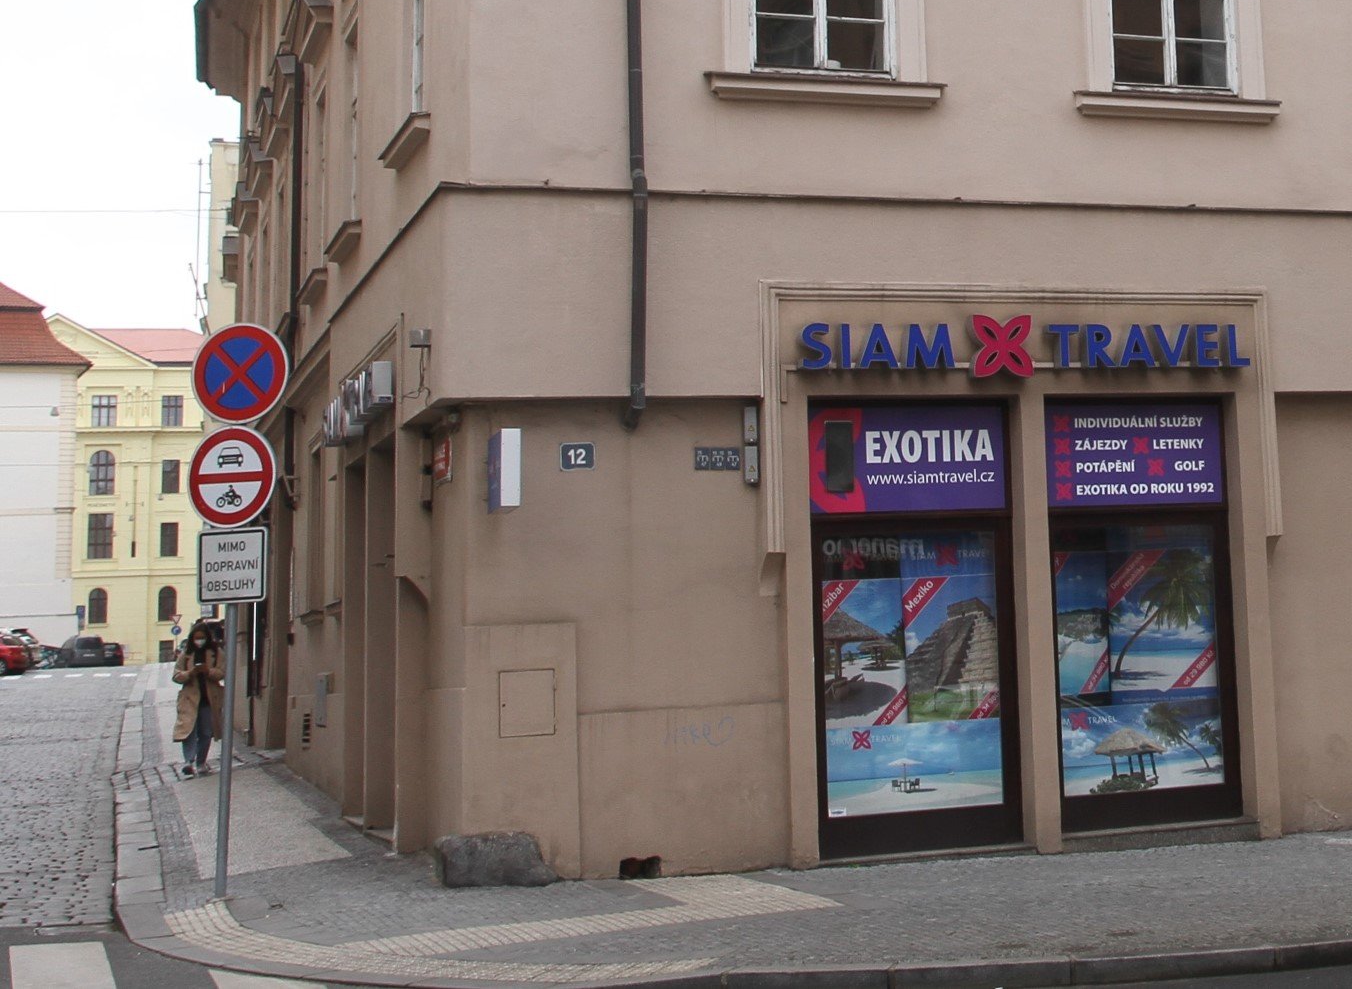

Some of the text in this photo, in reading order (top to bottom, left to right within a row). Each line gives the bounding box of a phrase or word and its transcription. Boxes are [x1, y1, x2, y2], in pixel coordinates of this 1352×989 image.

[800, 322, 1250, 369] SIAM TRAVEL
[1074, 415, 1203, 428] INDIVIDUÁLNÍ SLUŽBY
[865, 429, 994, 464] EXOTIKA
[1074, 438, 1128, 451] ZÁJEZDY
[1153, 438, 1204, 450] LETENKY
[567, 448, 586, 464] 12
[1076, 460, 1135, 473] POTÁPĚNÍ
[1174, 460, 1205, 471] GOLF
[867, 468, 995, 485] www.siamtravel.cz
[1076, 482, 1214, 496] EXOTIKA OD ROKU 1992
[218, 541, 246, 552] MIMO
[205, 556, 259, 573] DOPRAVNÍ
[207, 578, 256, 592] OBSLUHY
[905, 580, 934, 613] Mexiko
